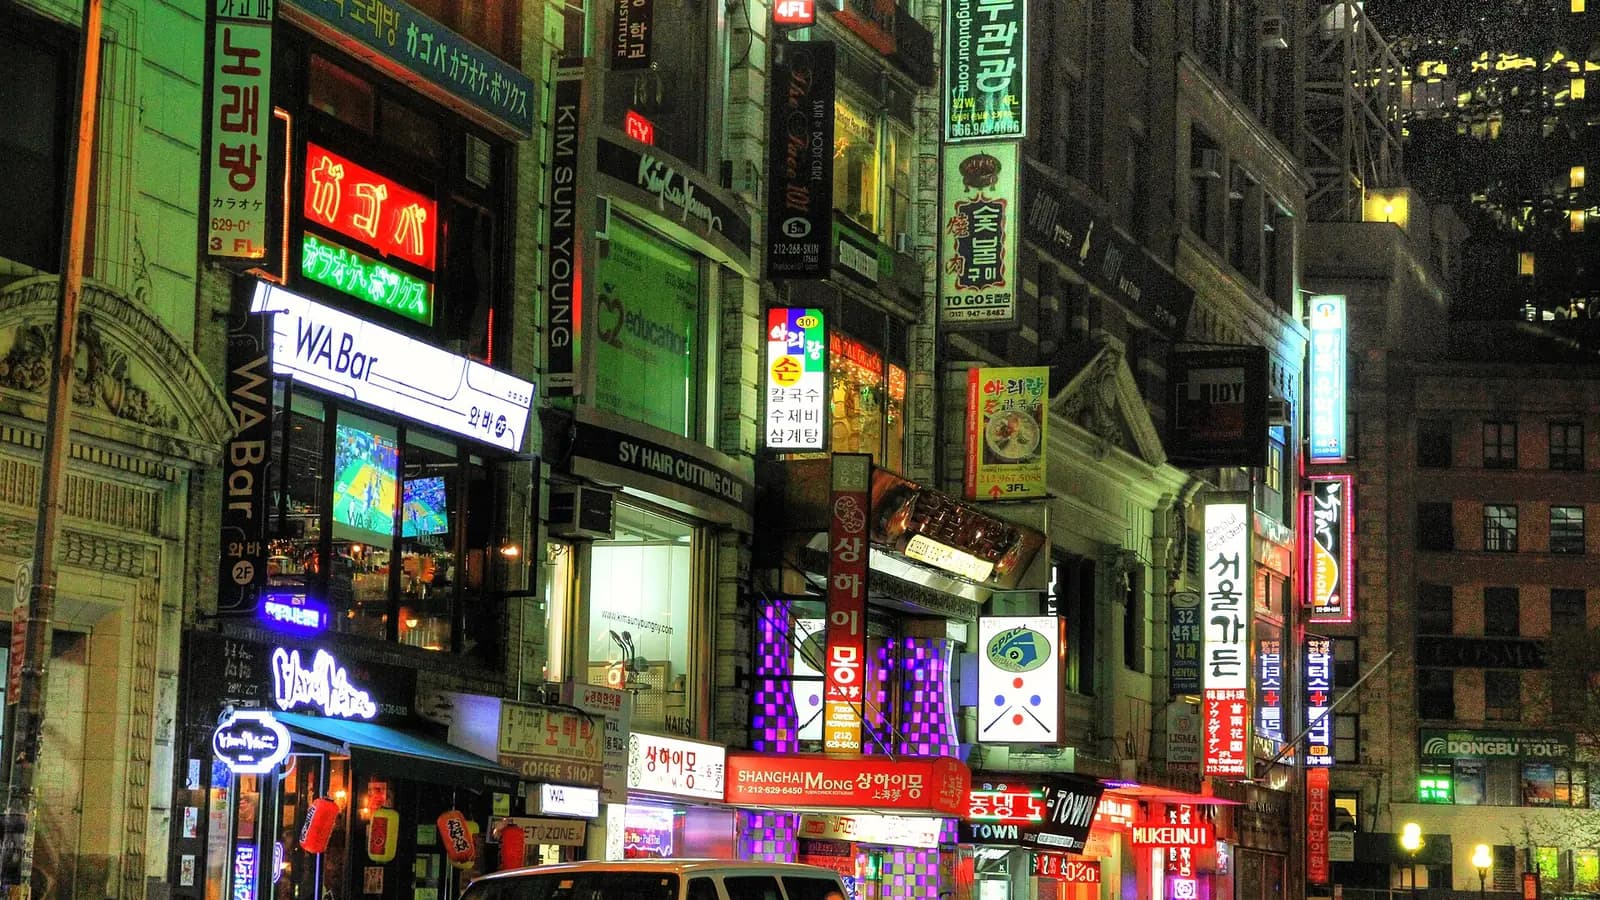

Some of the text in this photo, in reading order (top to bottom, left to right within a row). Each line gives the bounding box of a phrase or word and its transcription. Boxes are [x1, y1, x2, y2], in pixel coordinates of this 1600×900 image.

[777, 1, 810, 17] 4FL
[617, 0, 629, 57] NSTITUTE
[956, 0, 973, 92] ngbutour.com
[220, 28, 262, 192] 노래방
[213, 198, 263, 211] カラオケ
[551, 105, 576, 348] KIM SUN YOUNG
[210, 237, 222, 250] 3
[945, 294, 985, 306] TO GO
[799, 318, 816, 327] 301
[770, 323, 825, 361] 아리랑
[774, 357, 799, 382] 손
[771, 388, 819, 403] 칼국수
[468, 405, 493, 433] 와바
[771, 409, 818, 424] 수제비
[770, 428, 818, 444] 삼계탕
[618, 441, 744, 502] SY HAIR CUTTING CLUB
[830, 537, 864, 684] 상하이몽
[1178, 610, 1194, 624] 32
[1206, 551, 1246, 678] 서울가든
[1308, 653, 1331, 691] 닥터스
[605, 721, 619, 733] NTAL
[665, 715, 691, 734] NAILS
[1447, 741, 1520, 756] DONGBU
[522, 760, 595, 783] COFFEE SHOP
[645, 746, 697, 789] 상하이몽
[737, 770, 803, 783] SHANGHAI
[855, 773, 924, 799] 상하이몽
[1051, 789, 1097, 828] TOWN
[545, 826, 575, 840] ZONE
[970, 824, 1018, 839] TOWN
[1133, 827, 1206, 845] MUKEUNJI
